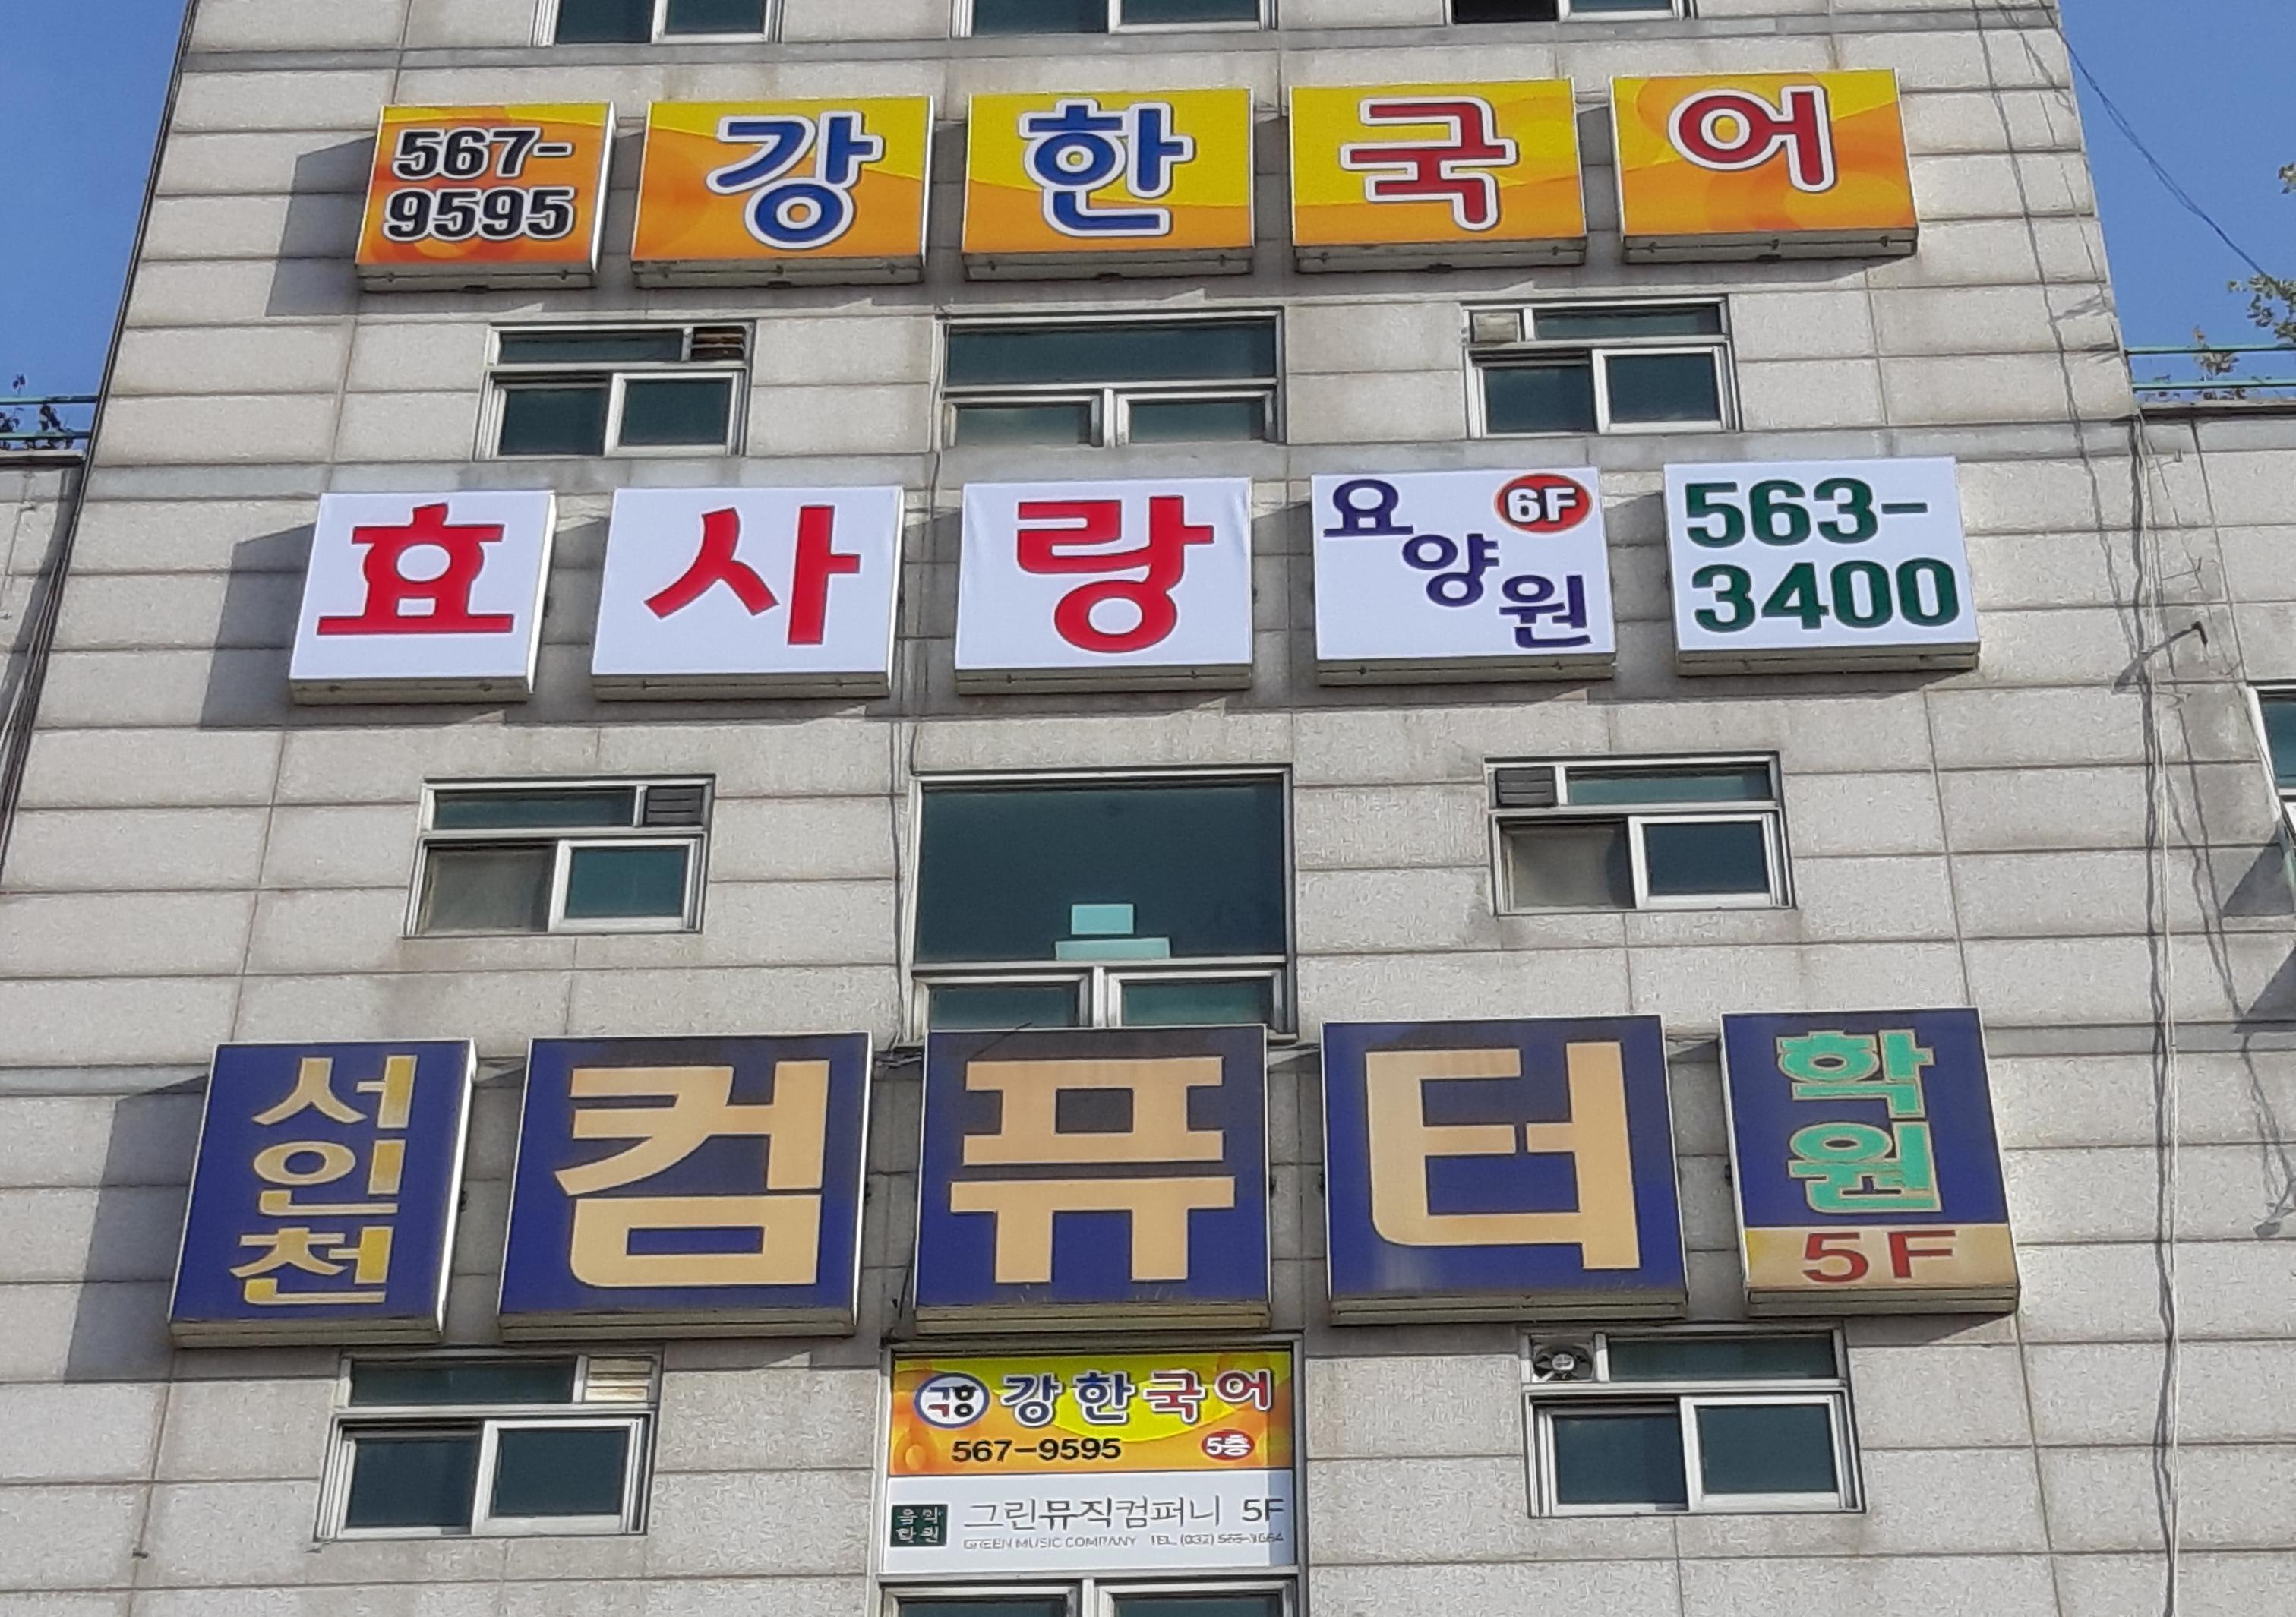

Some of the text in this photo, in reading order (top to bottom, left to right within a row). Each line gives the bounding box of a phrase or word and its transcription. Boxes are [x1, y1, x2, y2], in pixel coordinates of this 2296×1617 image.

[392, 126, 573, 179] 567-
[706, 84, 1835, 249] 강한국어
[384, 185, 576, 241] 9595
[1504, 484, 1580, 526] 6F
[1685, 477, 1928, 548] 563-
[316, 494, 1215, 654] 효사랑
[1323, 478, 1592, 649] 요양원
[1691, 557, 1960, 633] 3400
[1776, 1028, 1943, 1214] 학원
[229, 1054, 418, 1305] 서인천
[554, 1041, 1641, 1288] 컴퓨터
[1802, 1229, 1956, 1283] 5F
[1000, 1368, 1274, 1427] 강한국어
[952, 1437, 1122, 1463] 567-9595
[1206, 1434, 1252, 1457] 5층
[963, 1495, 1285, 1531] 그린뮤직컴퍼니 5F
[963, 1538, 1012, 1549] GREEN
[1015, 1536, 1062, 1549] MUSIC
[1065, 1535, 1137, 1548] COMPANY
